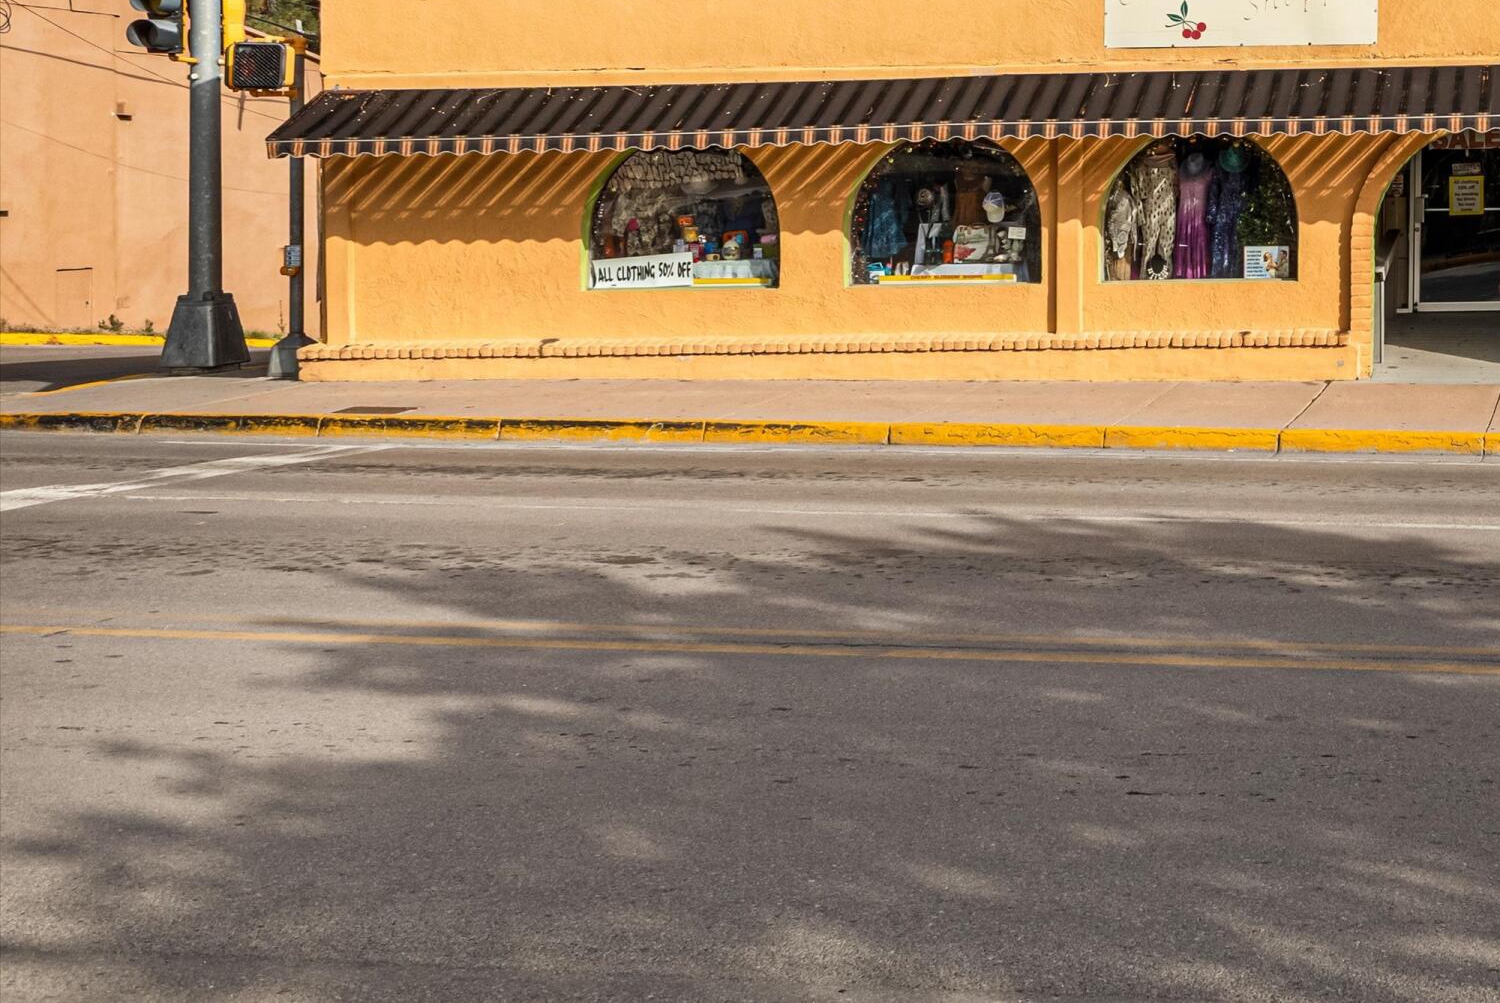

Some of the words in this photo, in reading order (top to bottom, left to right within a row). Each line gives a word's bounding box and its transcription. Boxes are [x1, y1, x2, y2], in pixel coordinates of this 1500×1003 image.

[598, 267, 613, 281] ALL
[616, 262, 655, 280] CLOTHING
[658, 262, 675, 278] 50%
[677, 261, 692, 278] OFF
